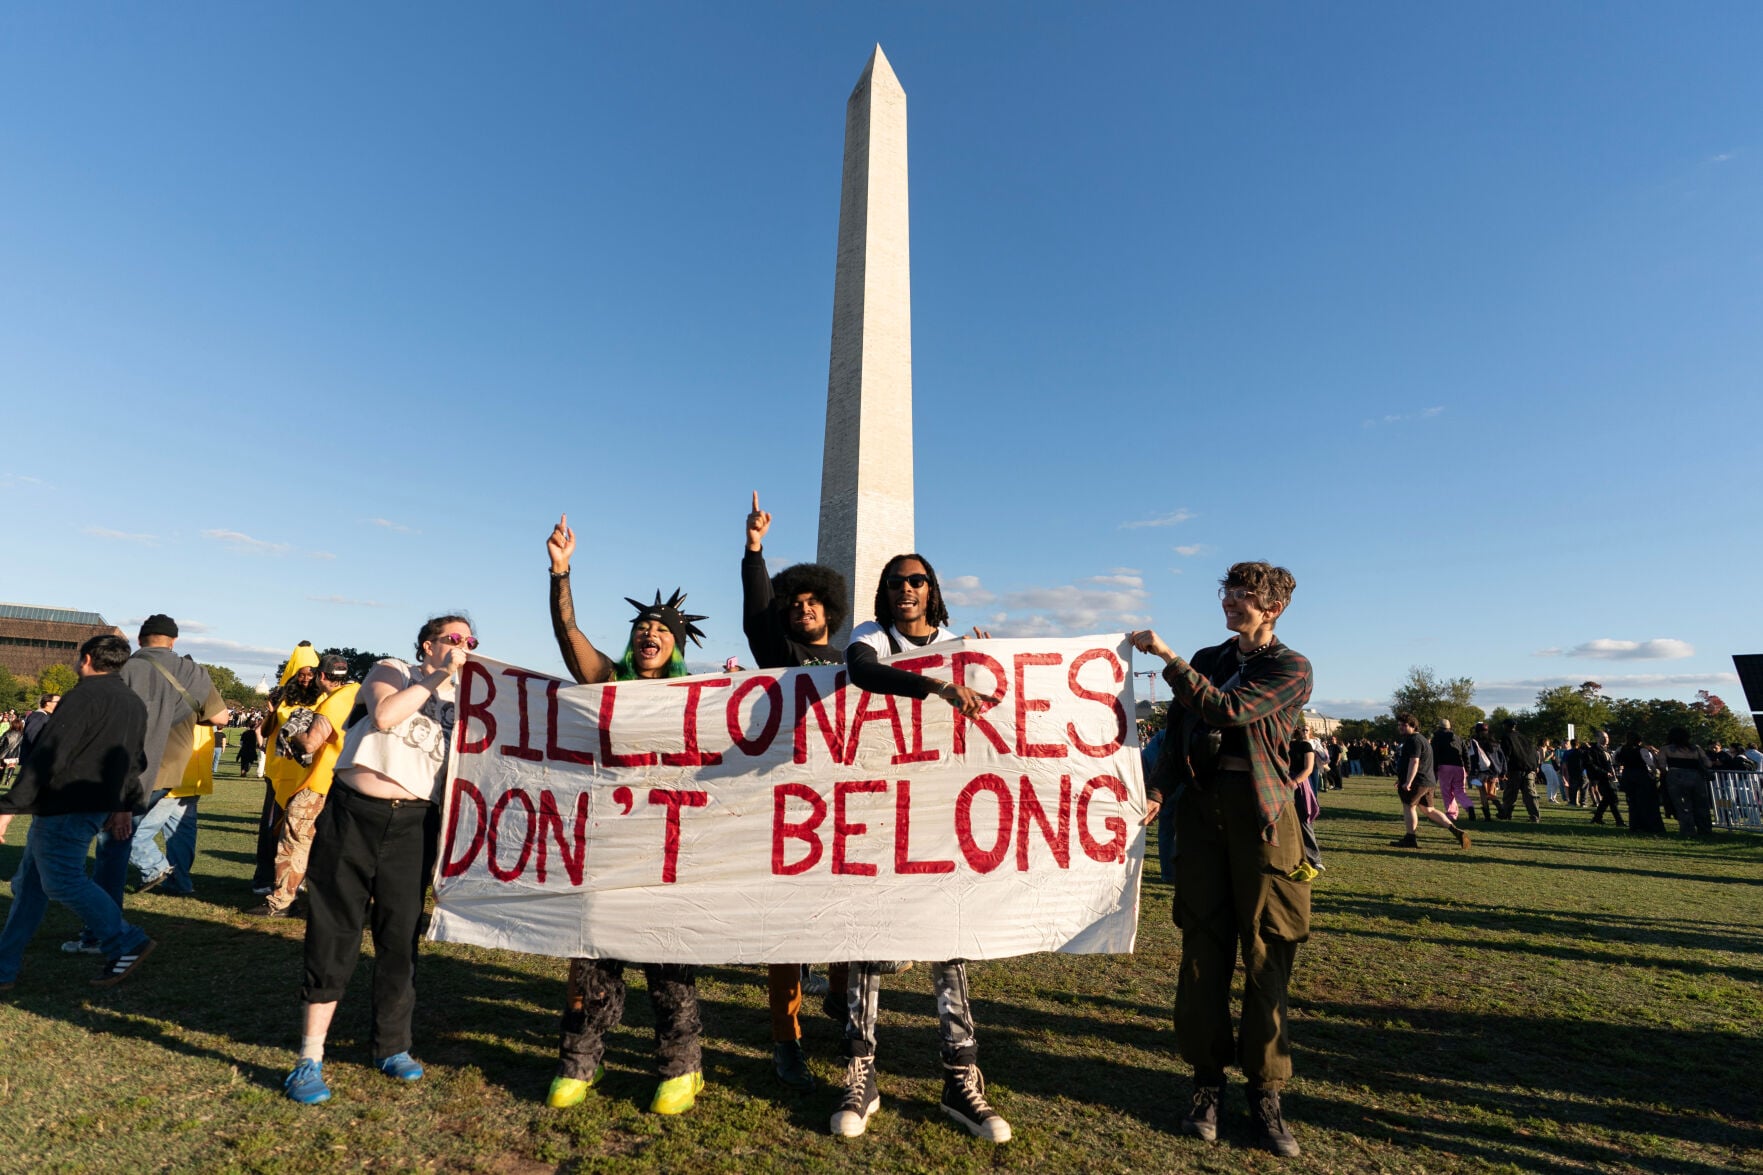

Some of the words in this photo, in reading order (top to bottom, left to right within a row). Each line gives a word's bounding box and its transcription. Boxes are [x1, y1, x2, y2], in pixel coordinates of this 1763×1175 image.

[457, 648, 1128, 768] BILLIONAIRES
[442, 779, 709, 886] DON'T
[772, 773, 1128, 877] BELONG
